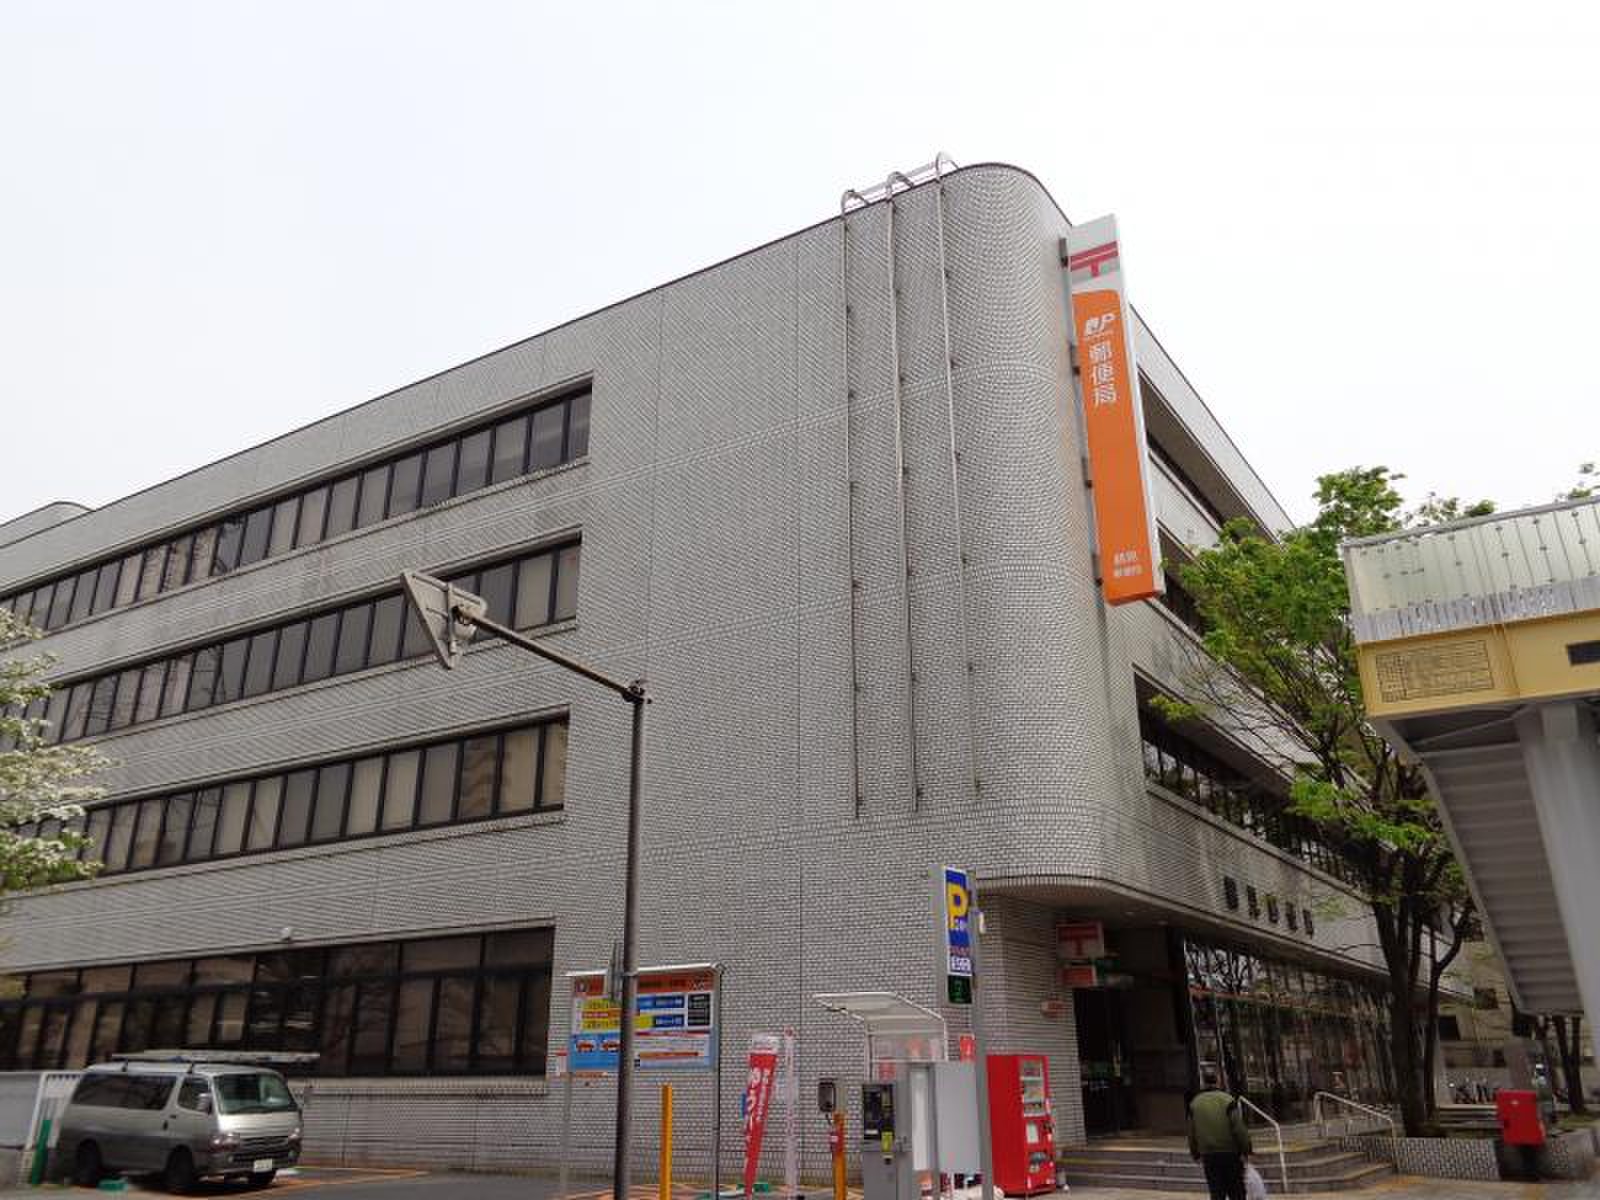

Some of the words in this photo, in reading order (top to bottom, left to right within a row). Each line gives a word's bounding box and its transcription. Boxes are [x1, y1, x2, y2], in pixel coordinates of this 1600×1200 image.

[1089, 340, 1117, 406] 郵便局
[946, 882, 970, 929] P
